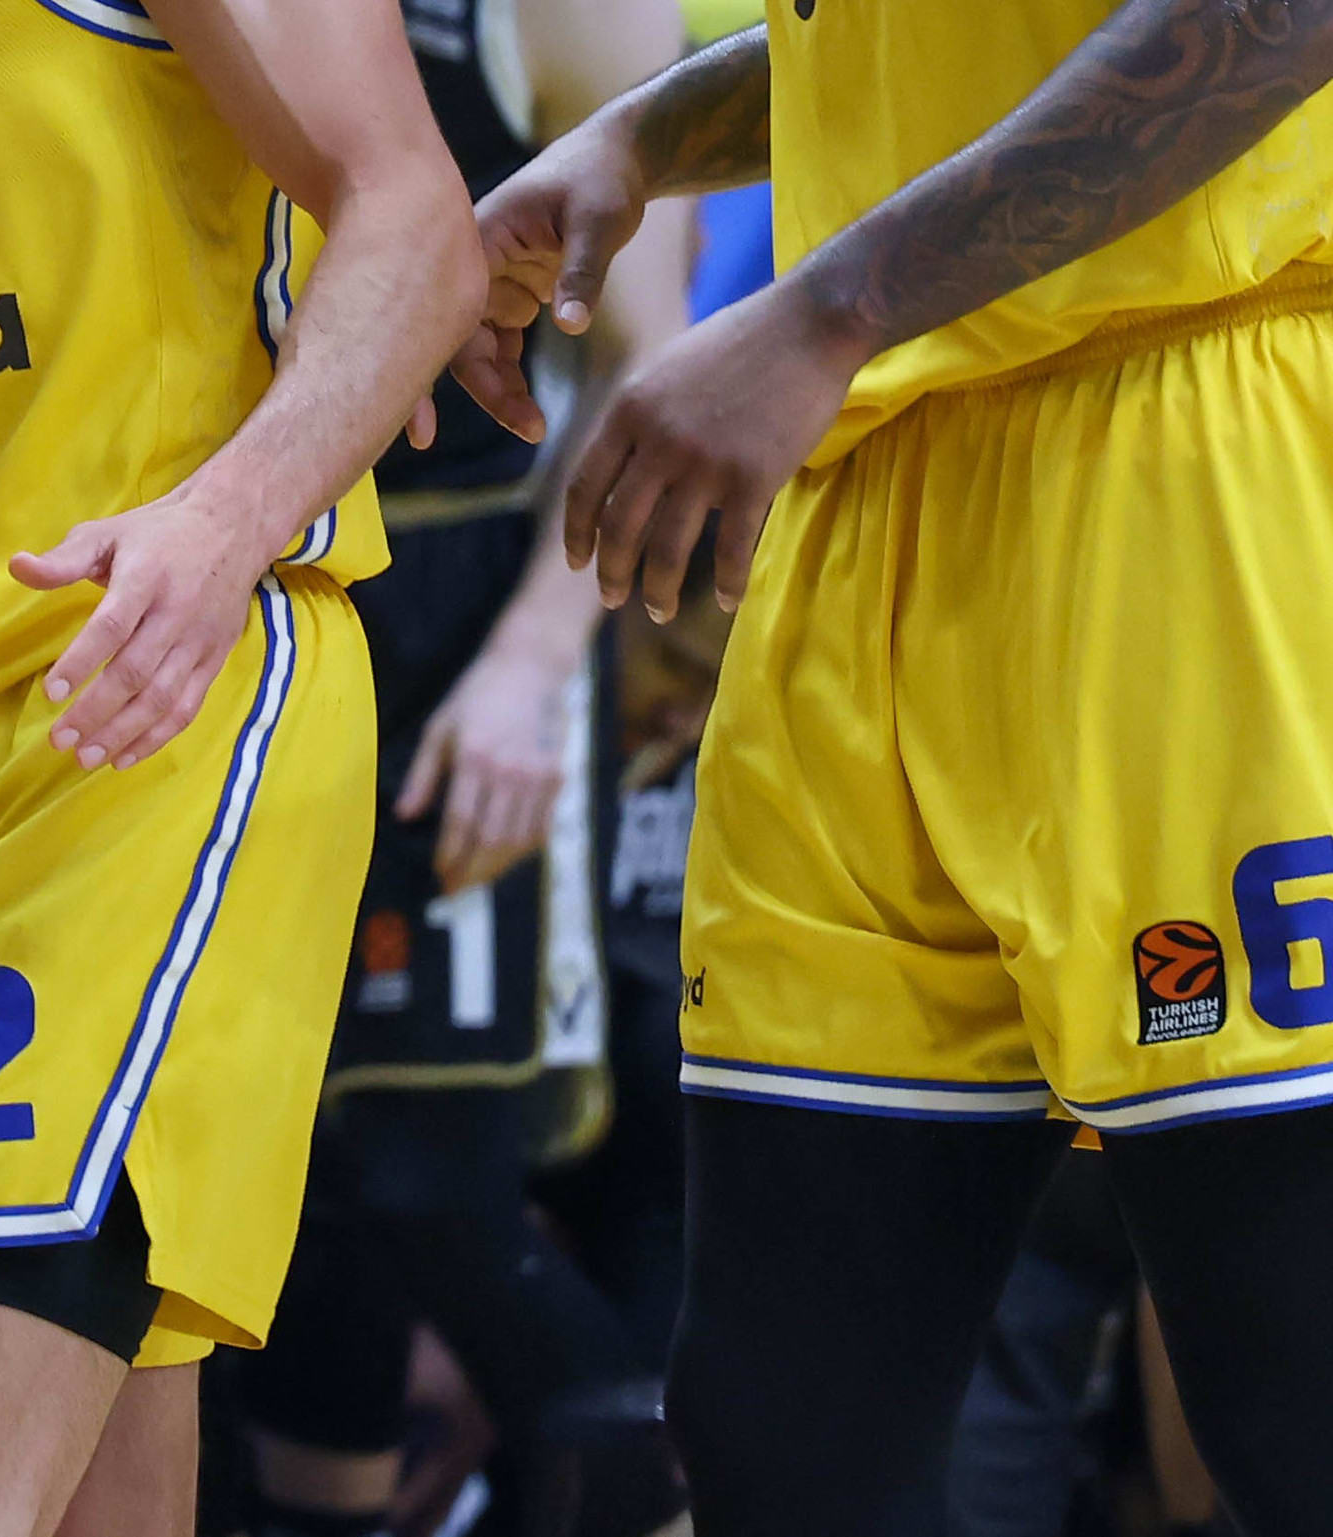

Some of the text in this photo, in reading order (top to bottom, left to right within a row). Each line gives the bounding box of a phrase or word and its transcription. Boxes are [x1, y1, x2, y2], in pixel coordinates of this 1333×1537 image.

[1232, 834, 1333, 1031] 6
[1147, 996, 1220, 1021] TURKISH
[1148, 1010, 1219, 1034] AIRLINES
